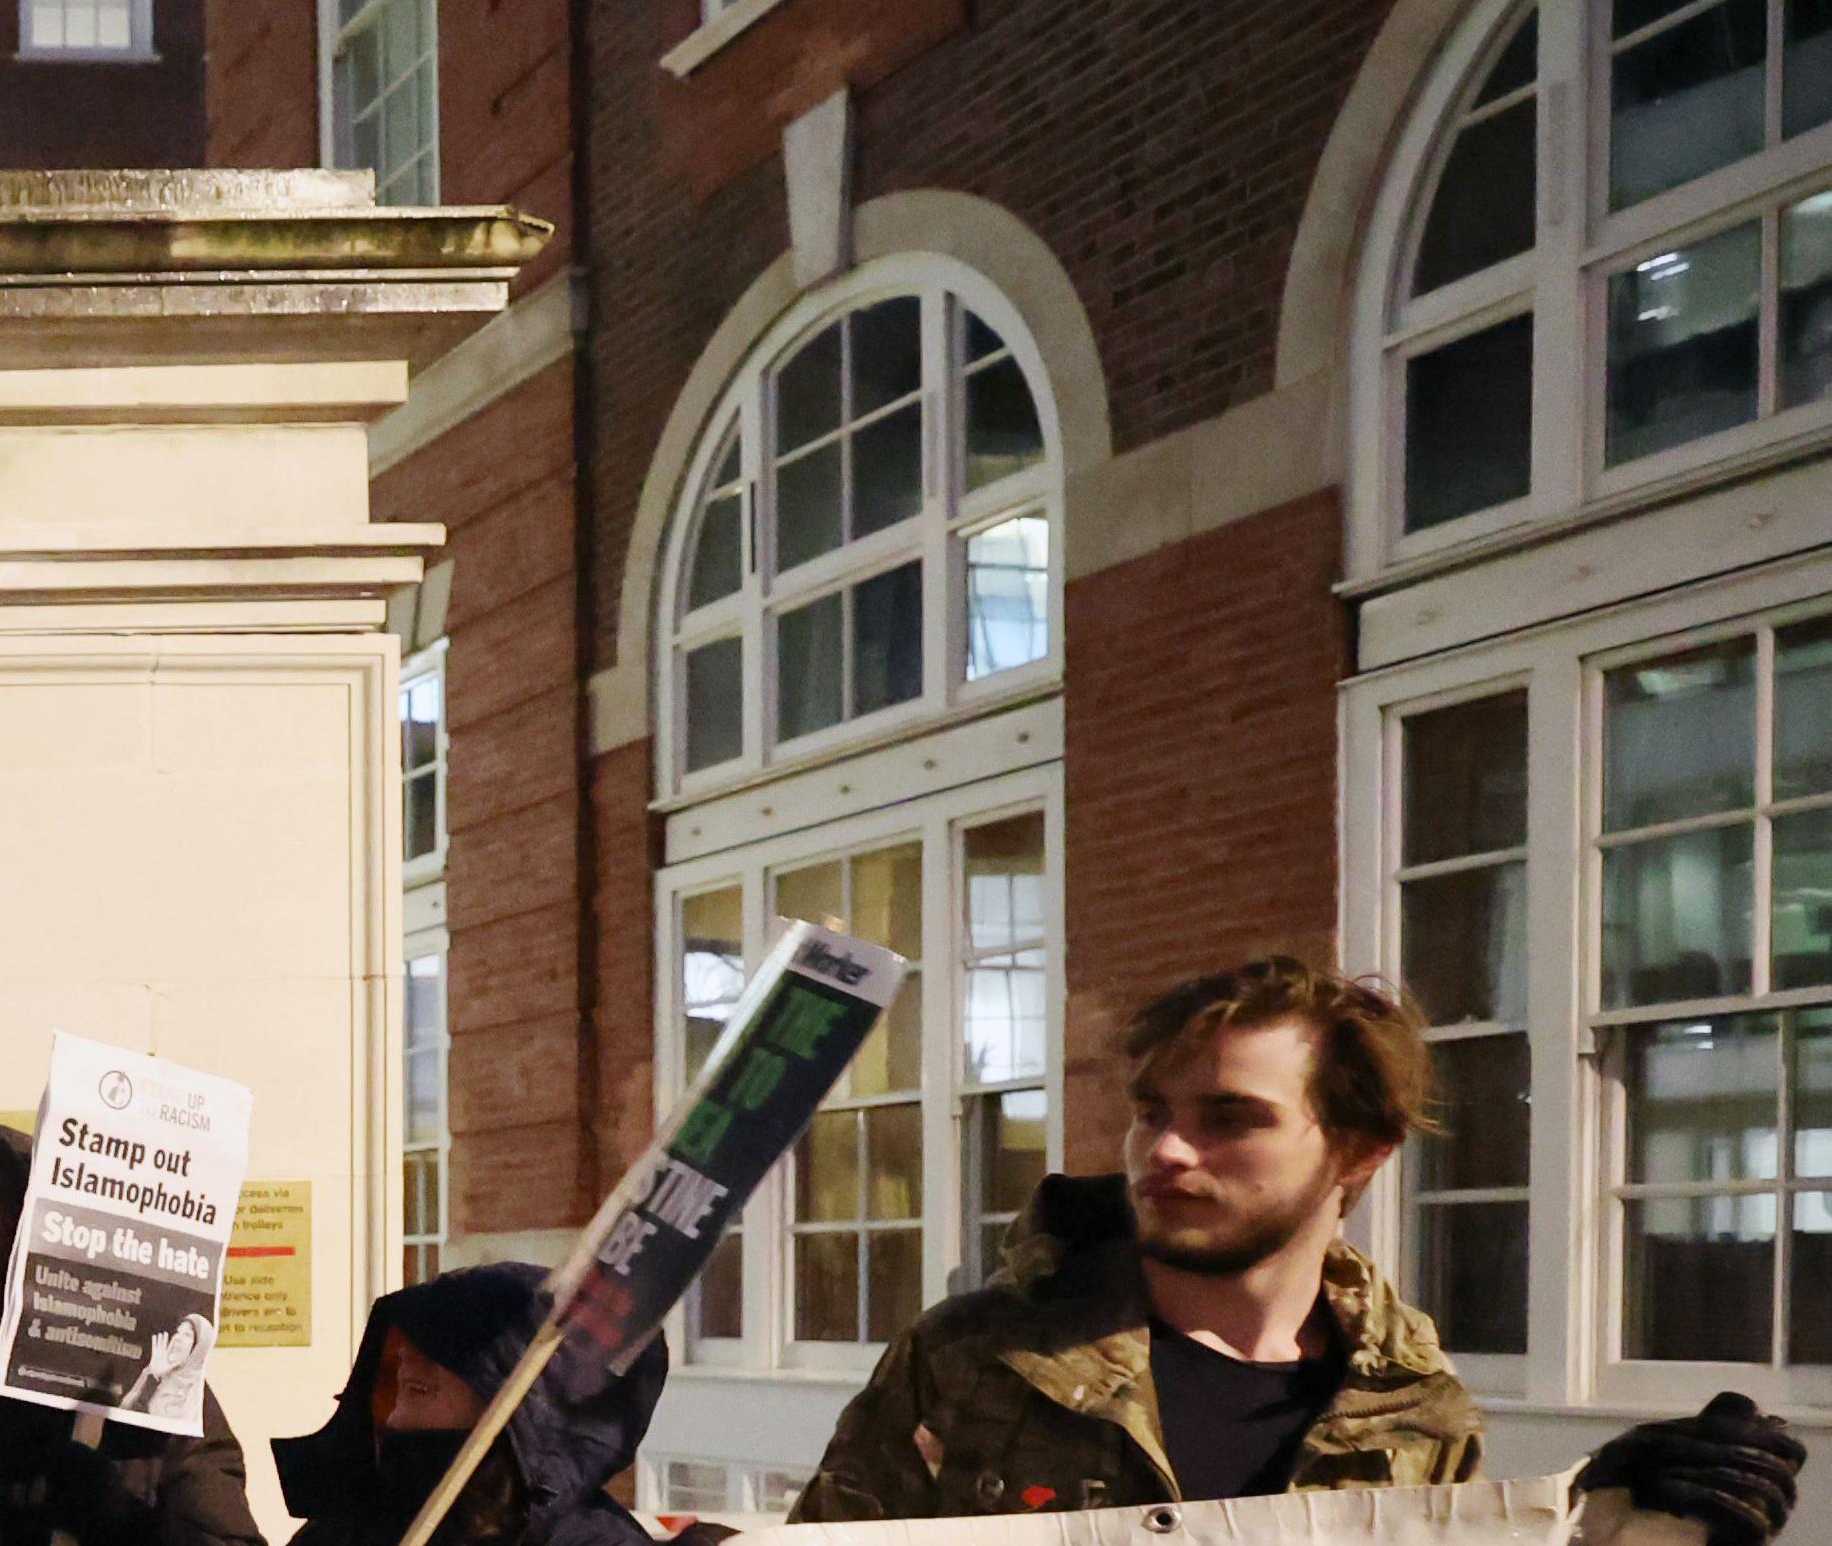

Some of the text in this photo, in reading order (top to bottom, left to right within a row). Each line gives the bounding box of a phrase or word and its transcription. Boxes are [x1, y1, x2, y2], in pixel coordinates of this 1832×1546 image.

[159, 1104, 212, 1134] RACISM
[187, 1092, 206, 1111] UP
[59, 1117, 192, 1178] Stamp out
[51, 1156, 217, 1226] Islamophobia
[41, 1210, 211, 1281] Stop the hate
